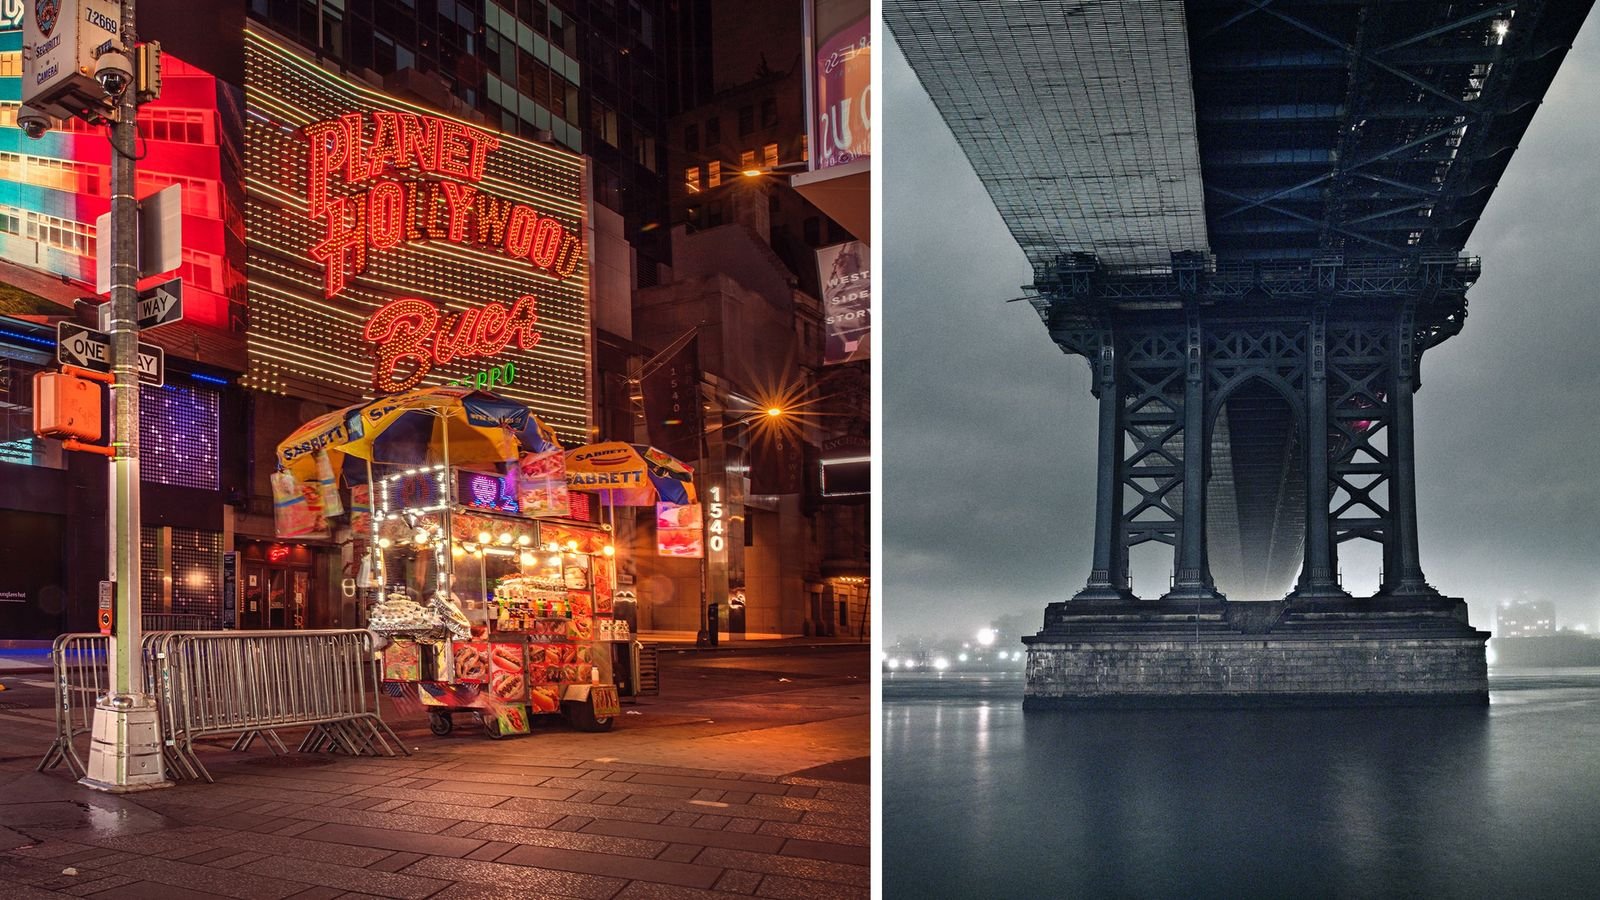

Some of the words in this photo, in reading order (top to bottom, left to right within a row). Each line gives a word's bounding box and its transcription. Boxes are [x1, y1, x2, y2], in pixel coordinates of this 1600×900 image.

[86, 7, 117, 35] 7-2669
[304, 112, 499, 219] PLANET
[311, 181, 582, 298] HOLLYWOOD
[828, 270, 869, 288] WEST
[143, 295, 168, 314] WAY
[831, 290, 869, 305] SIDE
[74, 339, 105, 360] ONE
[283, 425, 343, 460] SABRETT
[575, 448, 628, 461] SABRETT
[709, 486, 724, 552] 1540
